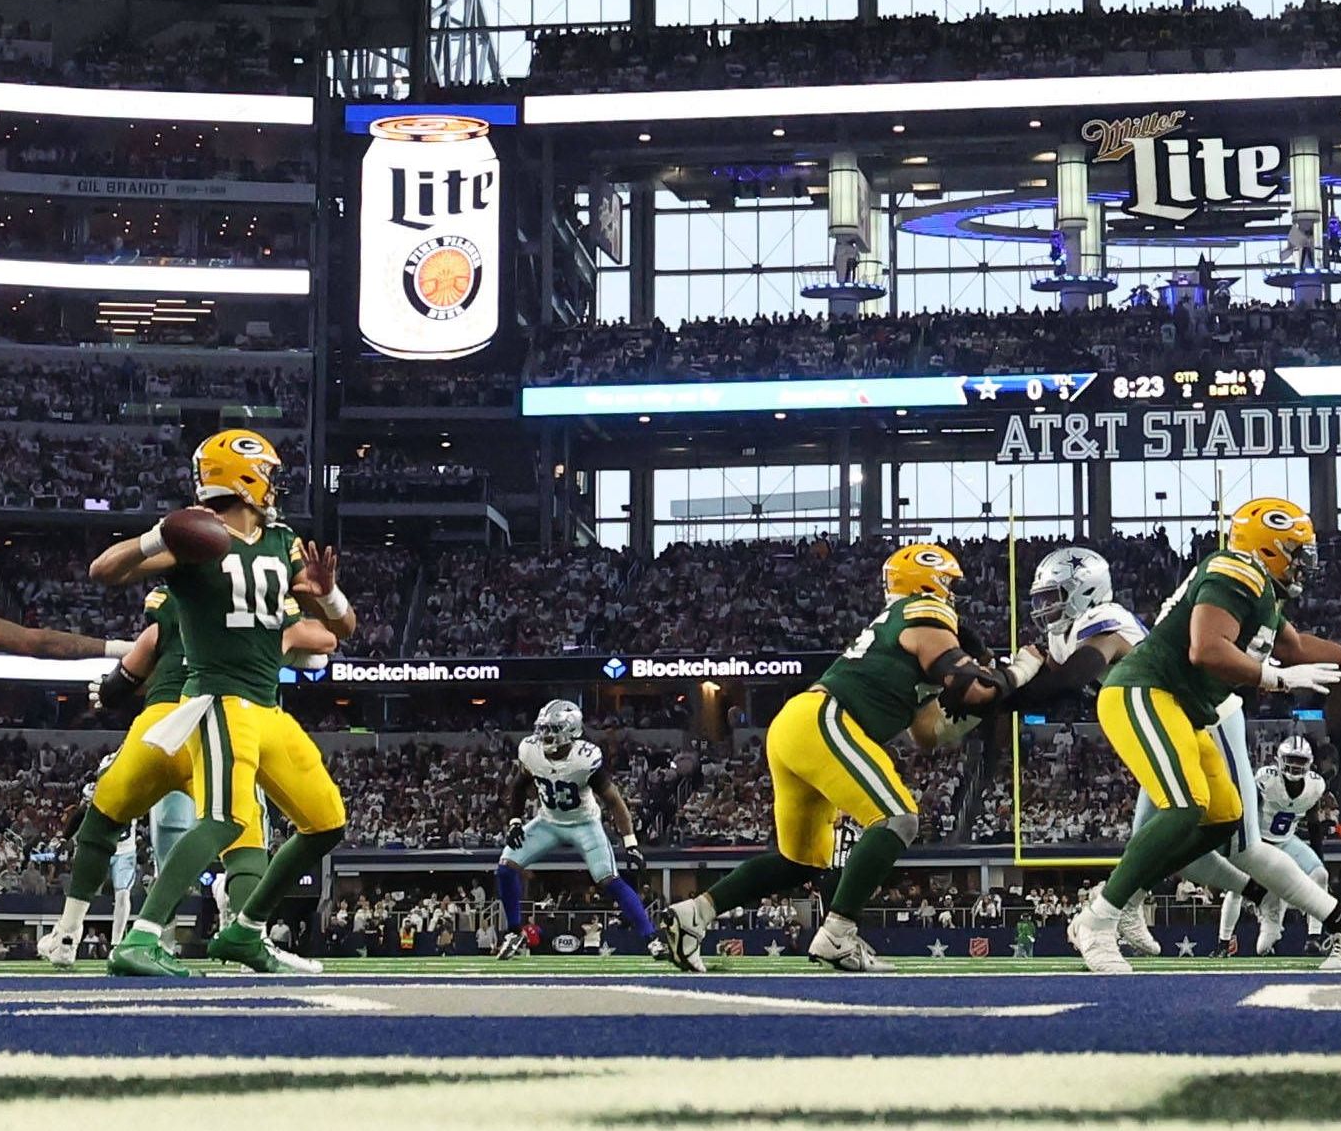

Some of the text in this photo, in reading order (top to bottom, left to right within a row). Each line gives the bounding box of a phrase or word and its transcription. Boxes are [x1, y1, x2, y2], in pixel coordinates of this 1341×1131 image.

[1081, 109, 1187, 163] Miller
[77, 180, 101, 194] GIL
[106, 181, 169, 195] BRANDT
[1124, 137, 1281, 221] Lite
[387, 166, 494, 231] Lite
[1026, 377, 1043, 400] 0
[1112, 375, 1165, 399] 8:23
[1182, 383, 1192, 398] 2
[996, 412, 1128, 462] AT&T
[221, 553, 289, 630] 10
[332, 661, 500, 681] Blockchain.com
[631, 657, 802, 678] Blockchain.com
[1269, 810, 1296, 837] 6
